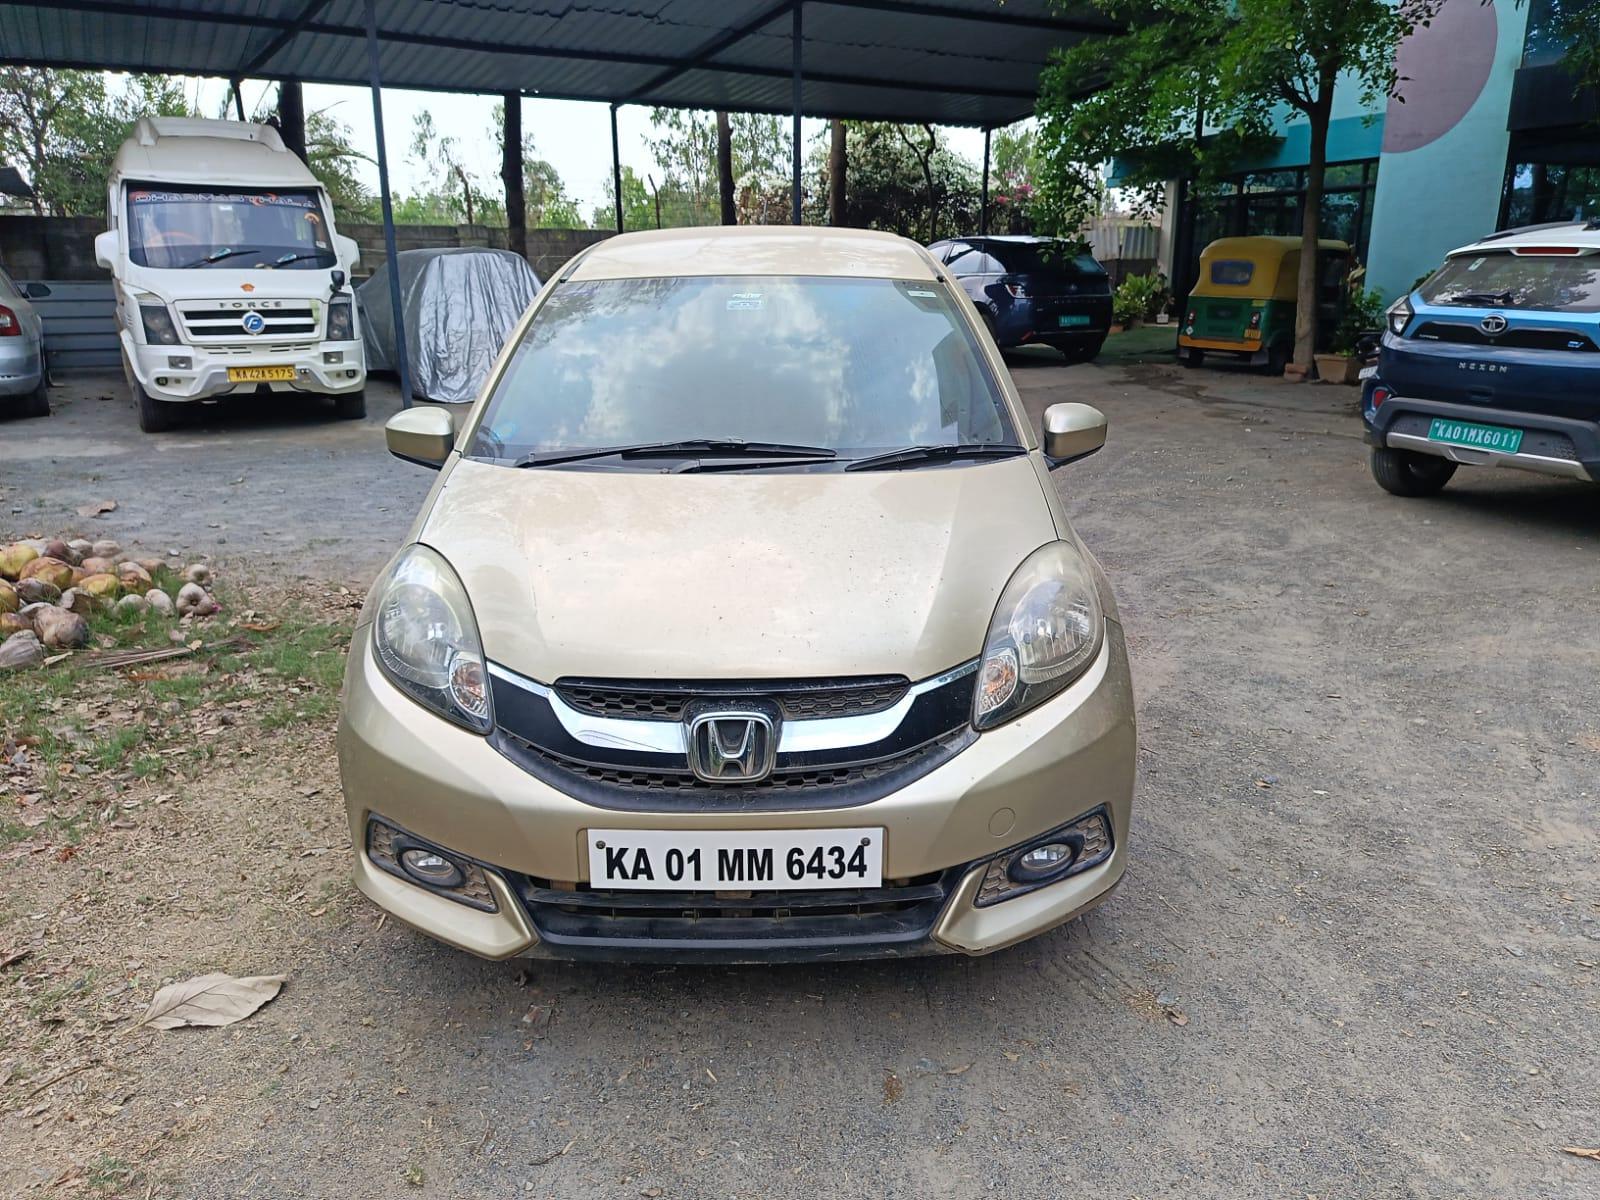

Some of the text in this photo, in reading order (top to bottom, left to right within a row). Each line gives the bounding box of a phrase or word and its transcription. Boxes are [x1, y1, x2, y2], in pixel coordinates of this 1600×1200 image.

[1458, 361, 1508, 373] NEXON
[605, 845, 867, 881] KA 01 MM 6434
